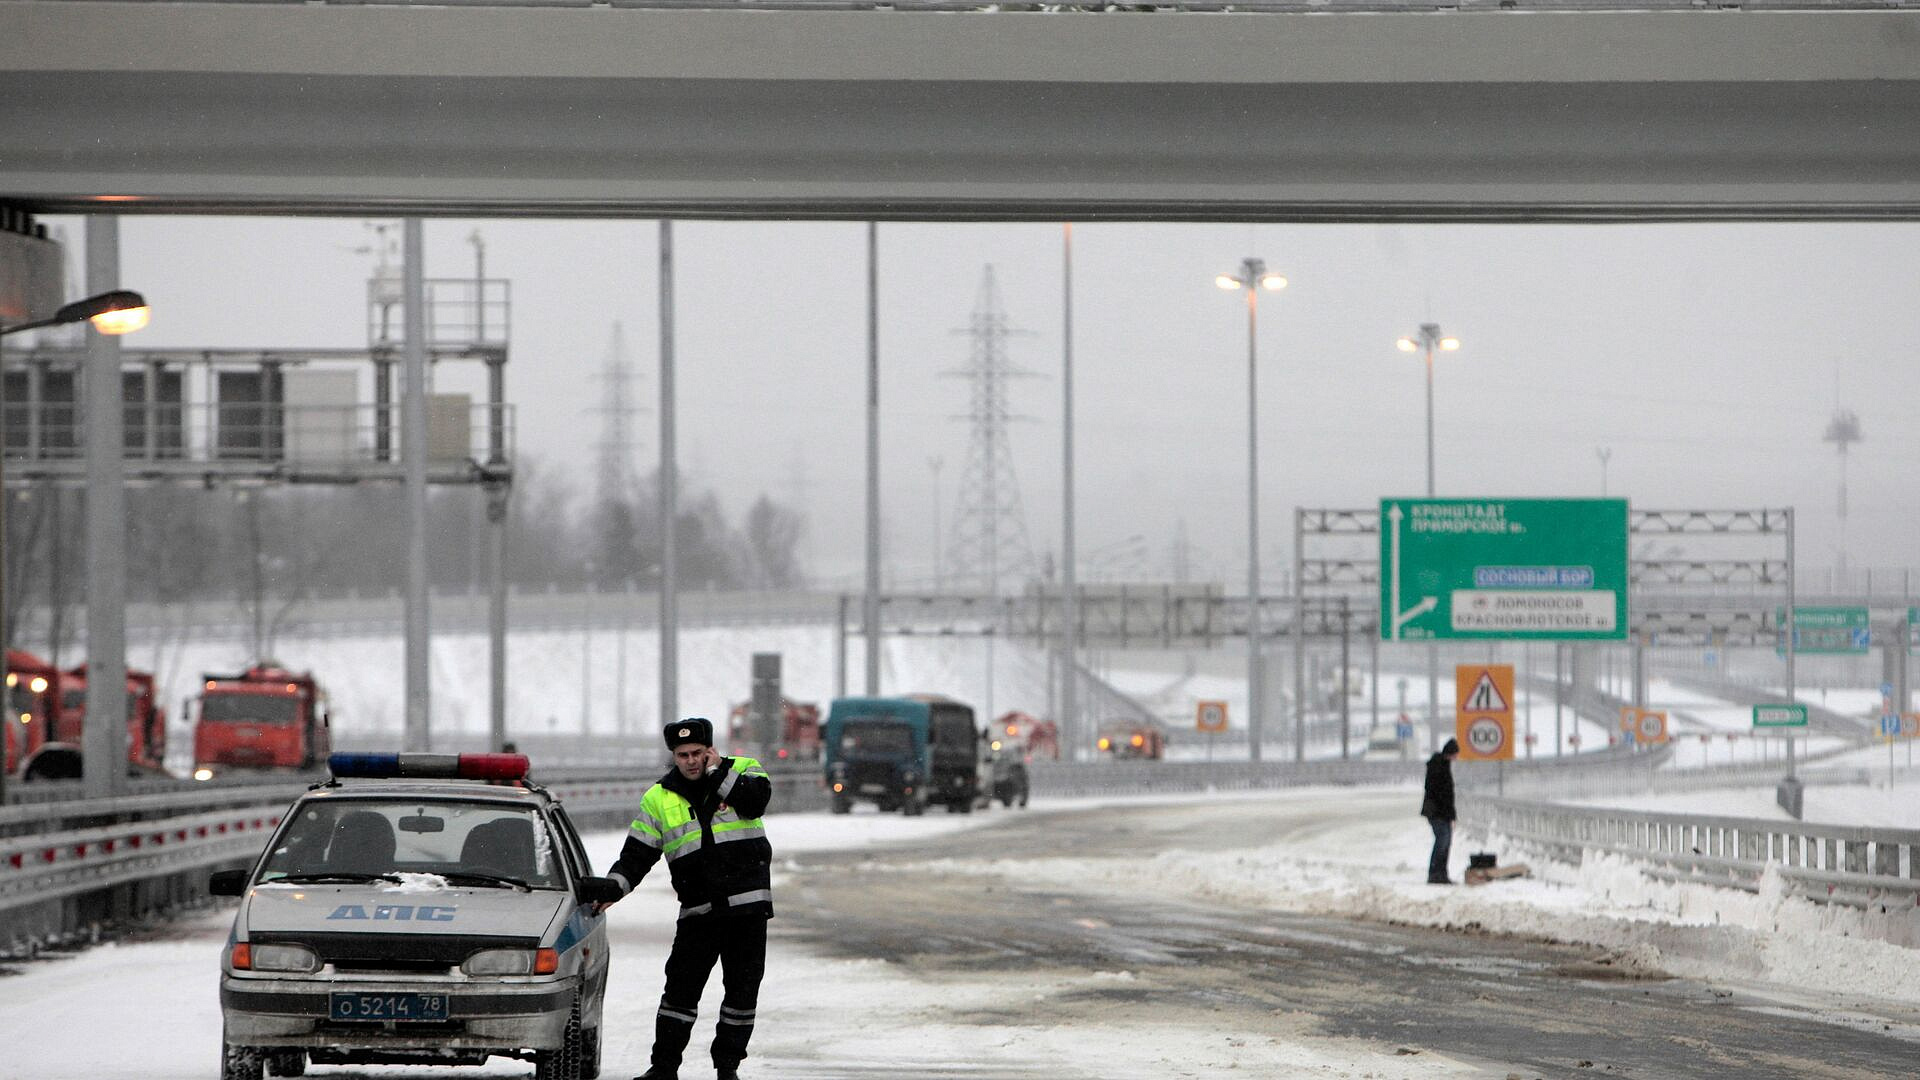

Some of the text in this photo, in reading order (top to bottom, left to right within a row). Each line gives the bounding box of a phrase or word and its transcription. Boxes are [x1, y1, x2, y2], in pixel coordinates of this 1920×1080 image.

[1411, 504, 1505, 519] КРОНШТАДТ
[1411, 519, 1508, 533] ПРИМОРСКОЕ
[1478, 569, 1590, 583] СОСНОВЫЙ БОР
[1495, 597, 1583, 610] ЛОМОНОСОВ
[1457, 614, 1591, 626] КРАСНОФЛОТСКОЕ
[1472, 728, 1498, 745] 100
[326, 905, 456, 921] ДПС
[360, 997, 408, 1016] 5214
[421, 997, 440, 1011] 78
